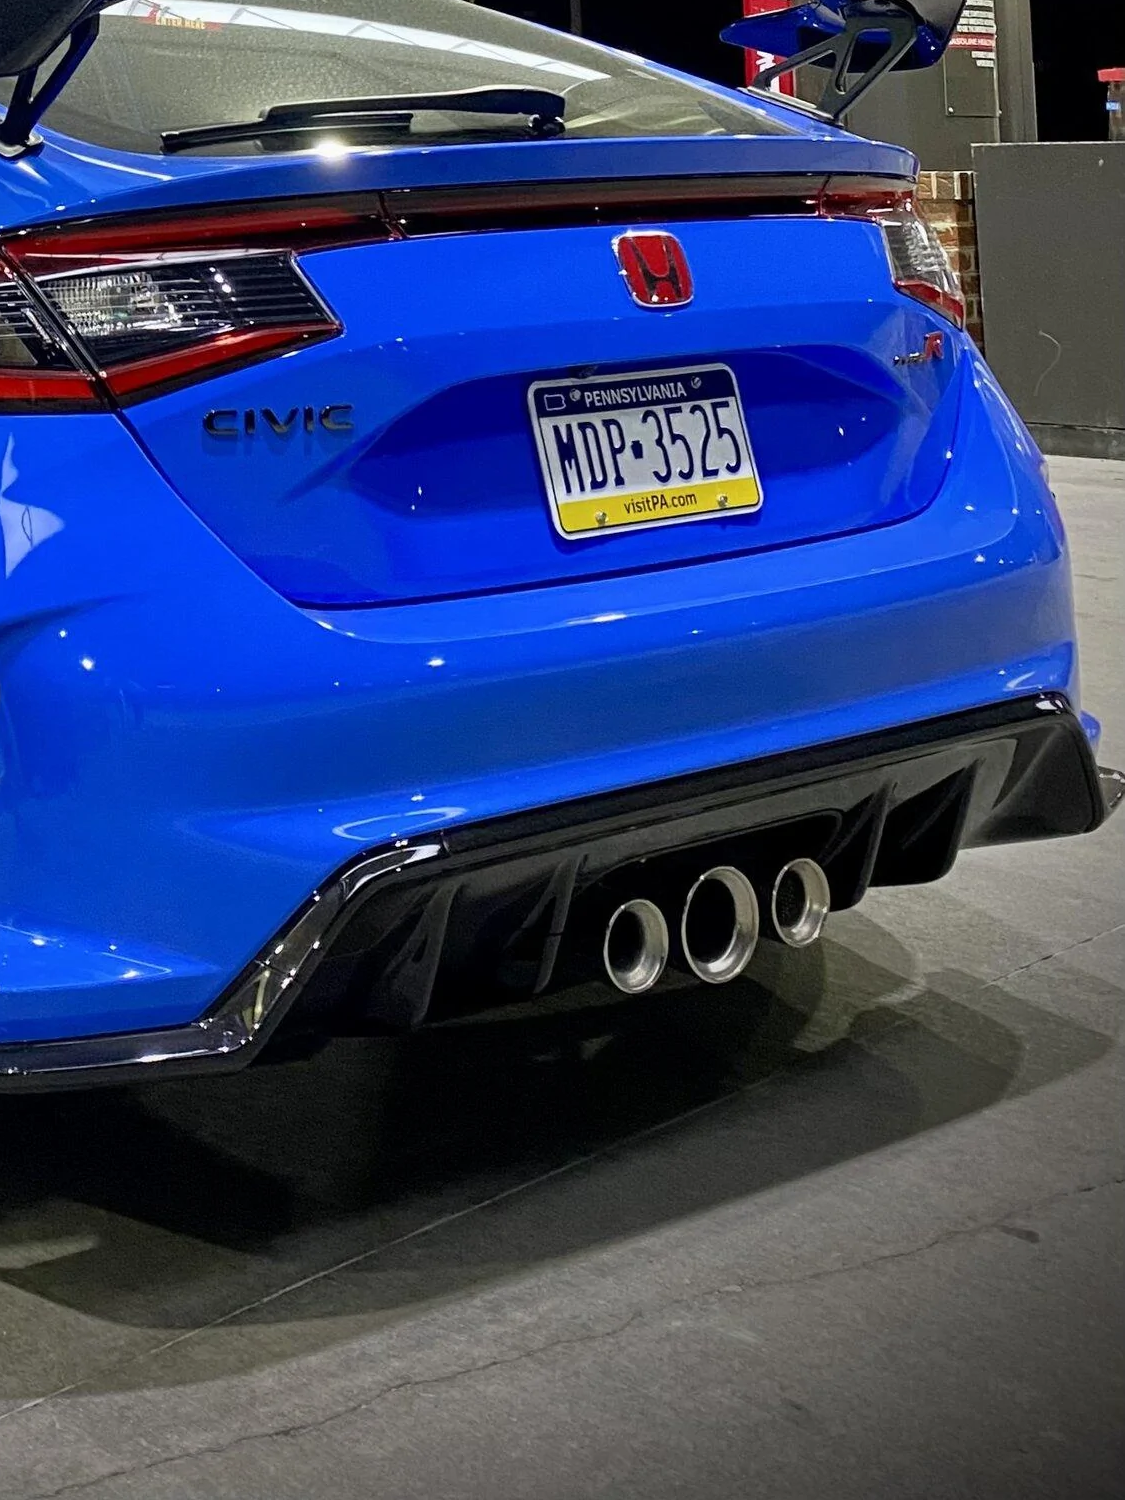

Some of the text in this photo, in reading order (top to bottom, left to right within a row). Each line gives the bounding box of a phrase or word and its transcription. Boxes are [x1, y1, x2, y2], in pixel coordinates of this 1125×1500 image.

[584, 381, 688, 408] PENNSYLVANIA
[202, 403, 355, 436] CIVIC
[623, 492, 698, 515] visitPA.com
